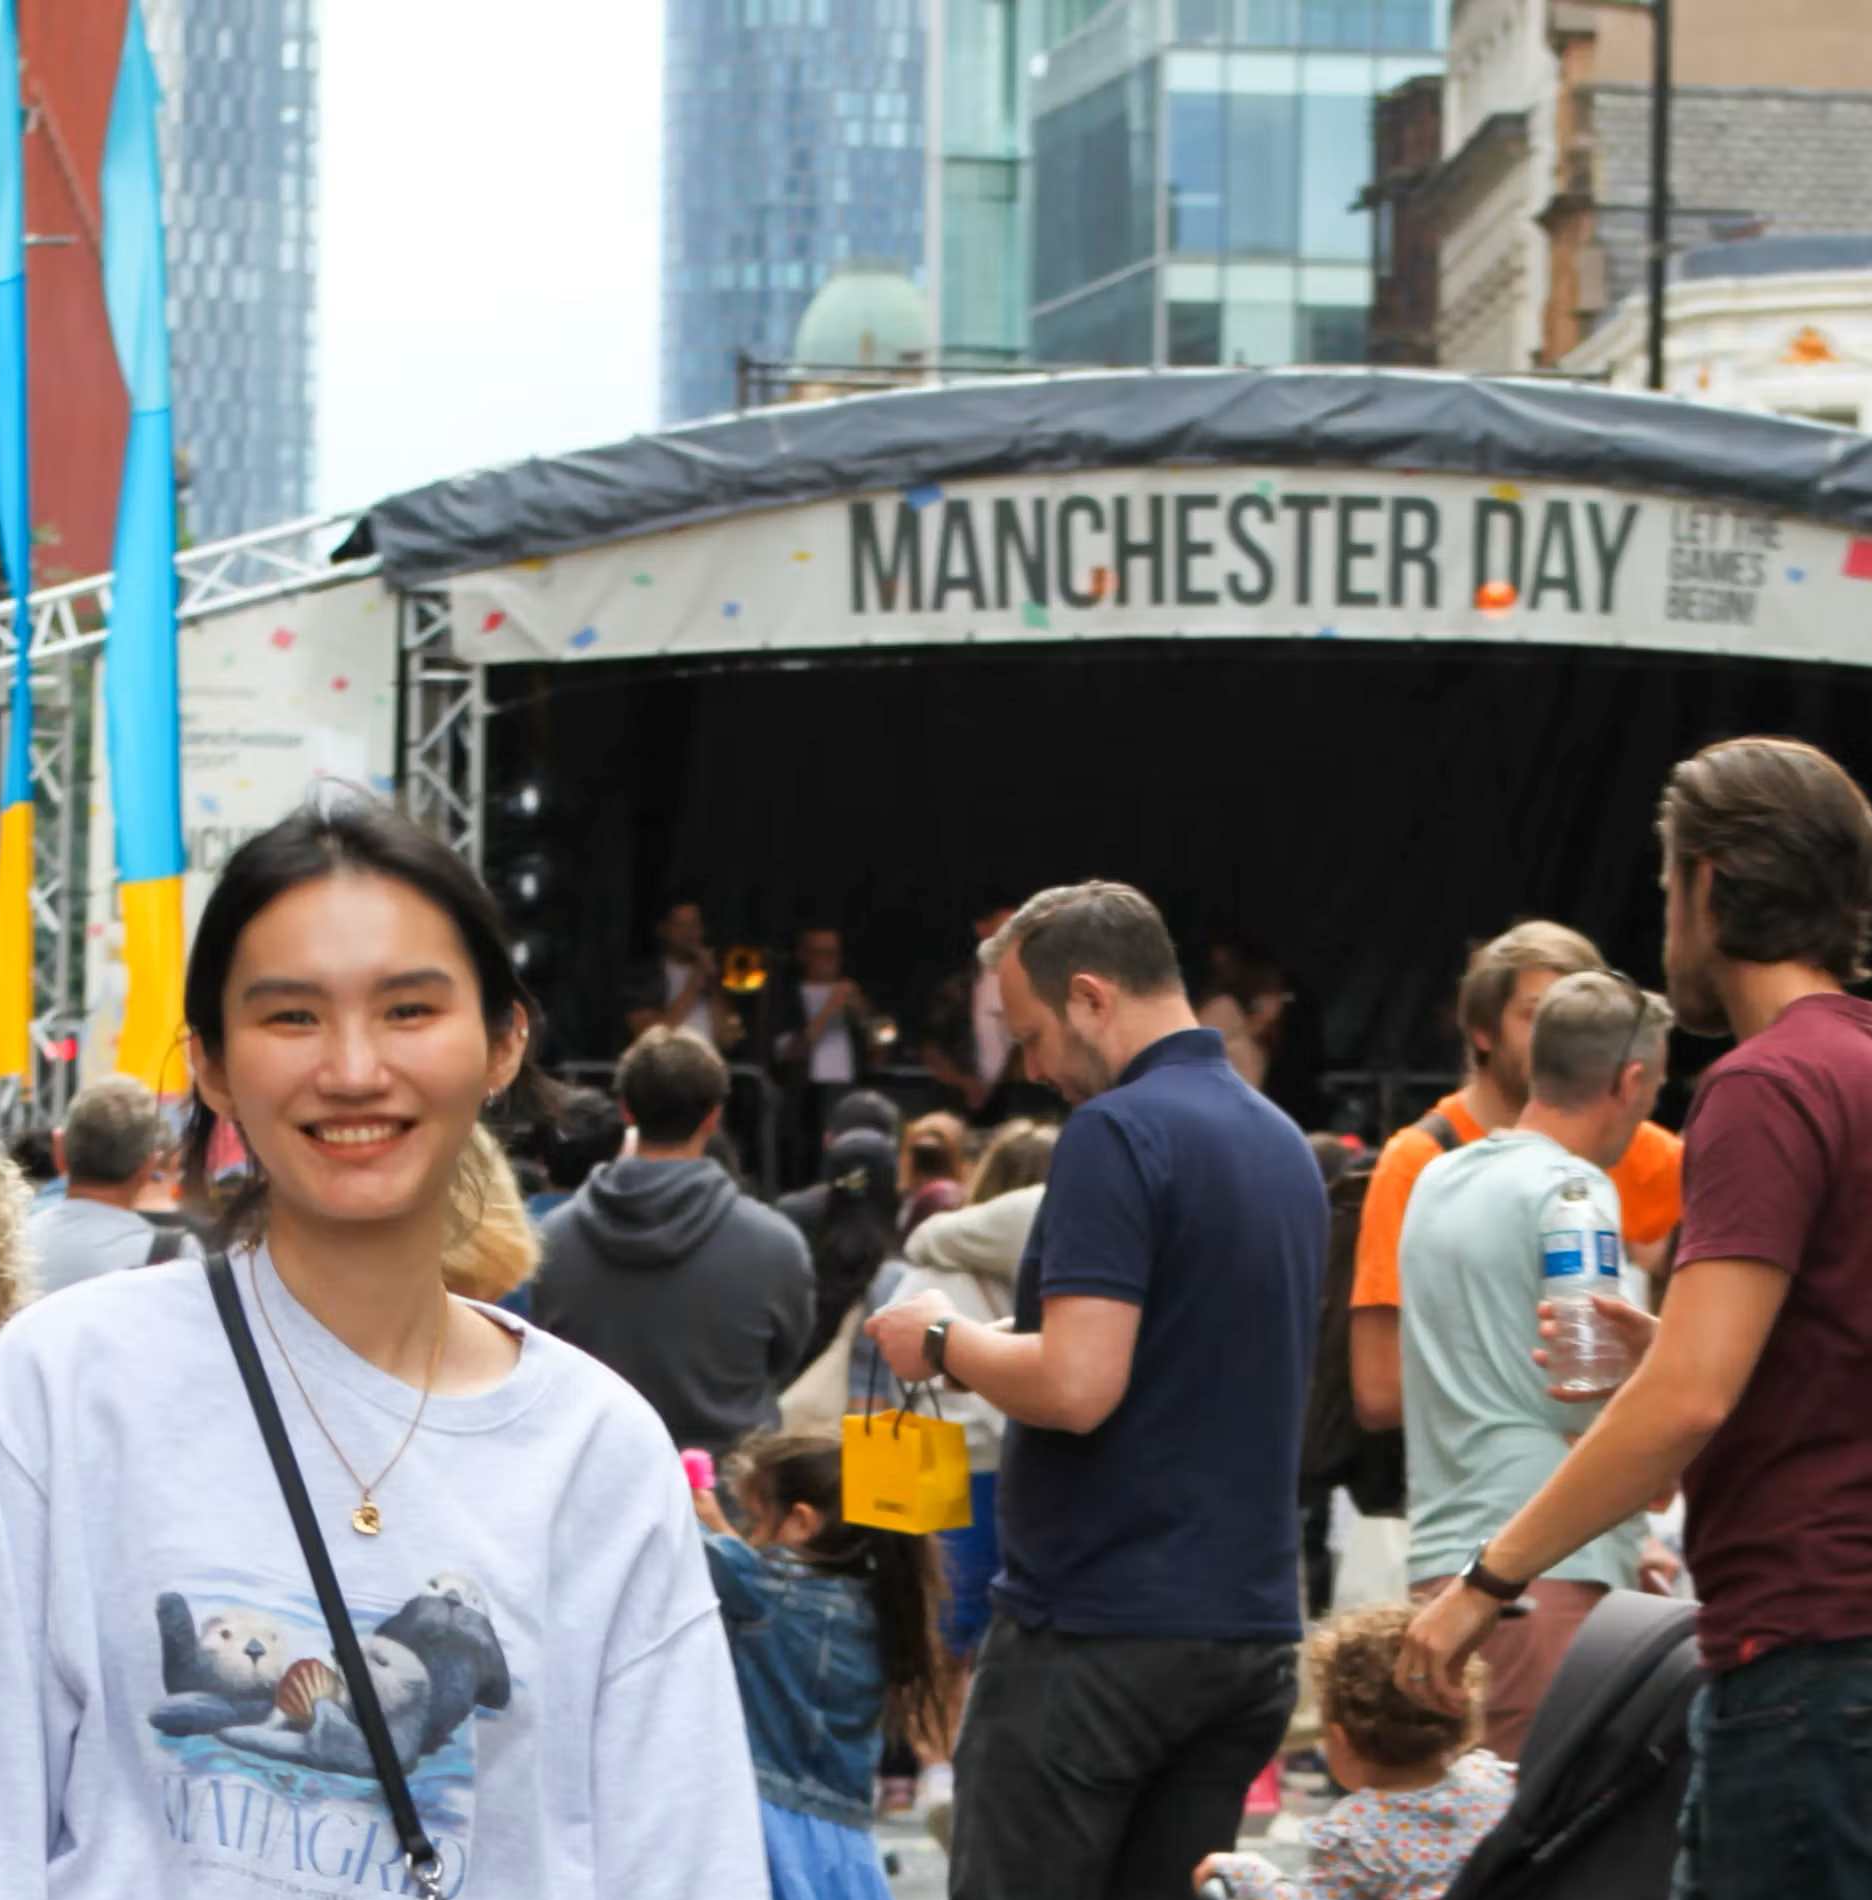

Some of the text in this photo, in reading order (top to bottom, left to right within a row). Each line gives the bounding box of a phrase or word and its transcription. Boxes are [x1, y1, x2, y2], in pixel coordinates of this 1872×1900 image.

[1672, 505, 1785, 550] LET THE
[849, 492, 1641, 614] MANCHESTER DAY
[1670, 547, 1766, 587] GAMES
